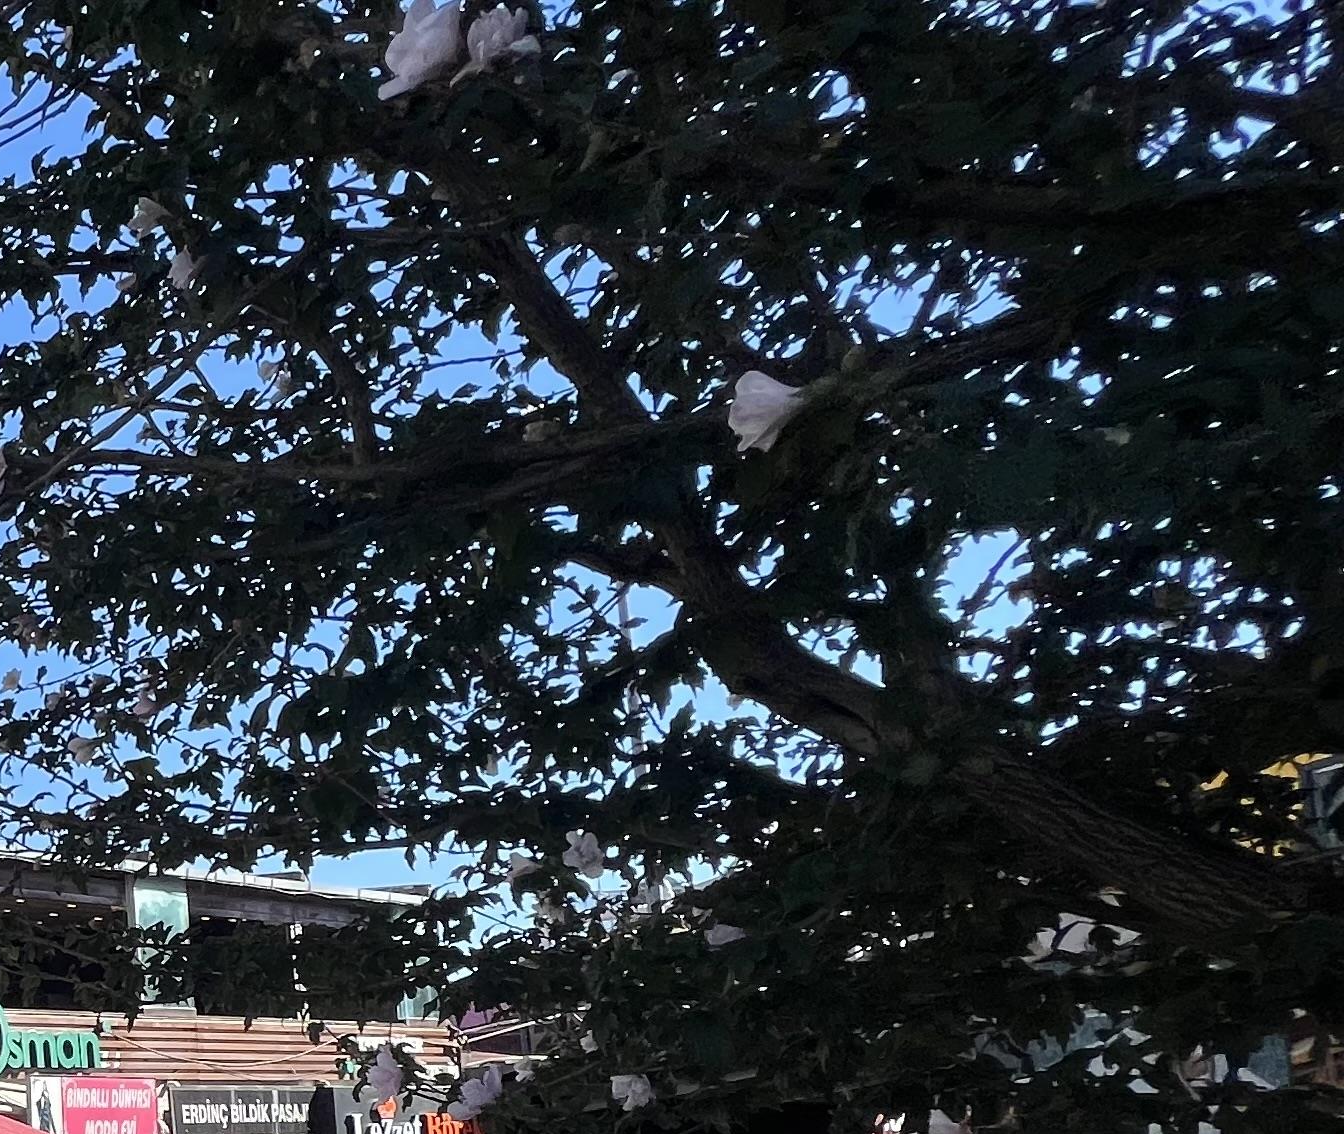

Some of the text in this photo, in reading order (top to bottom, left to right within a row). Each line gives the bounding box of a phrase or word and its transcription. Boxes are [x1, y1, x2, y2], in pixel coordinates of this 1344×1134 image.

[66, 1082, 151, 1110] BİNDALLI DÜNYASI
[182, 1099, 229, 1129] ERDİNÇ
[230, 1099, 269, 1124] BİLDİK
